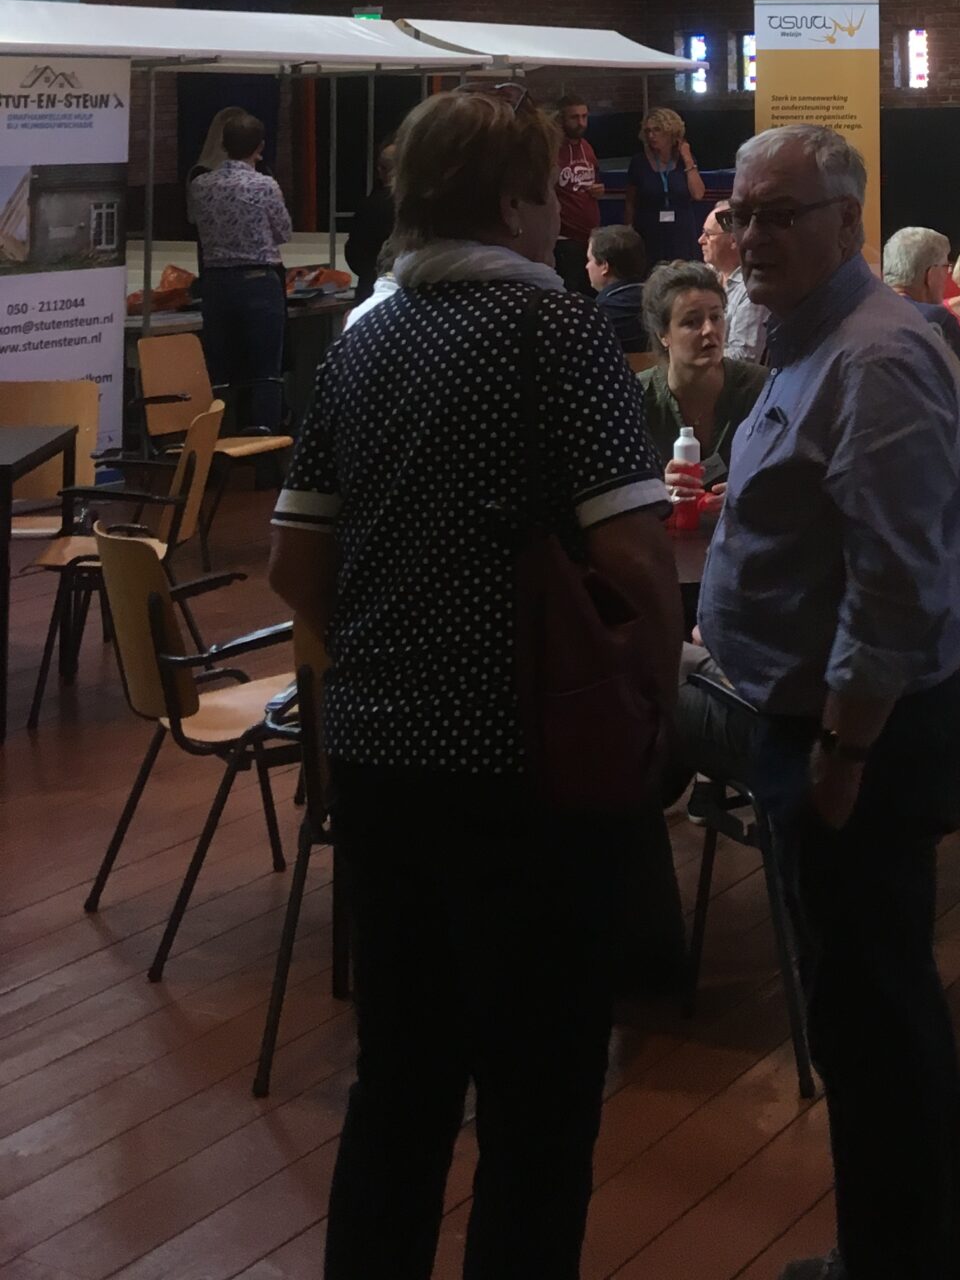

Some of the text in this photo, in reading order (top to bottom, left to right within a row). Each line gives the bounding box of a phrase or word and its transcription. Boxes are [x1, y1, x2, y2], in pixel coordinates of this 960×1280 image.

[798, 94, 848, 103] samenwerking
[781, 104, 830, 112] ondersteuning
[815, 113, 856, 121] organisaties
[7, 303, 28, 315] 050
[38, 298, 85, 312] 2112044
